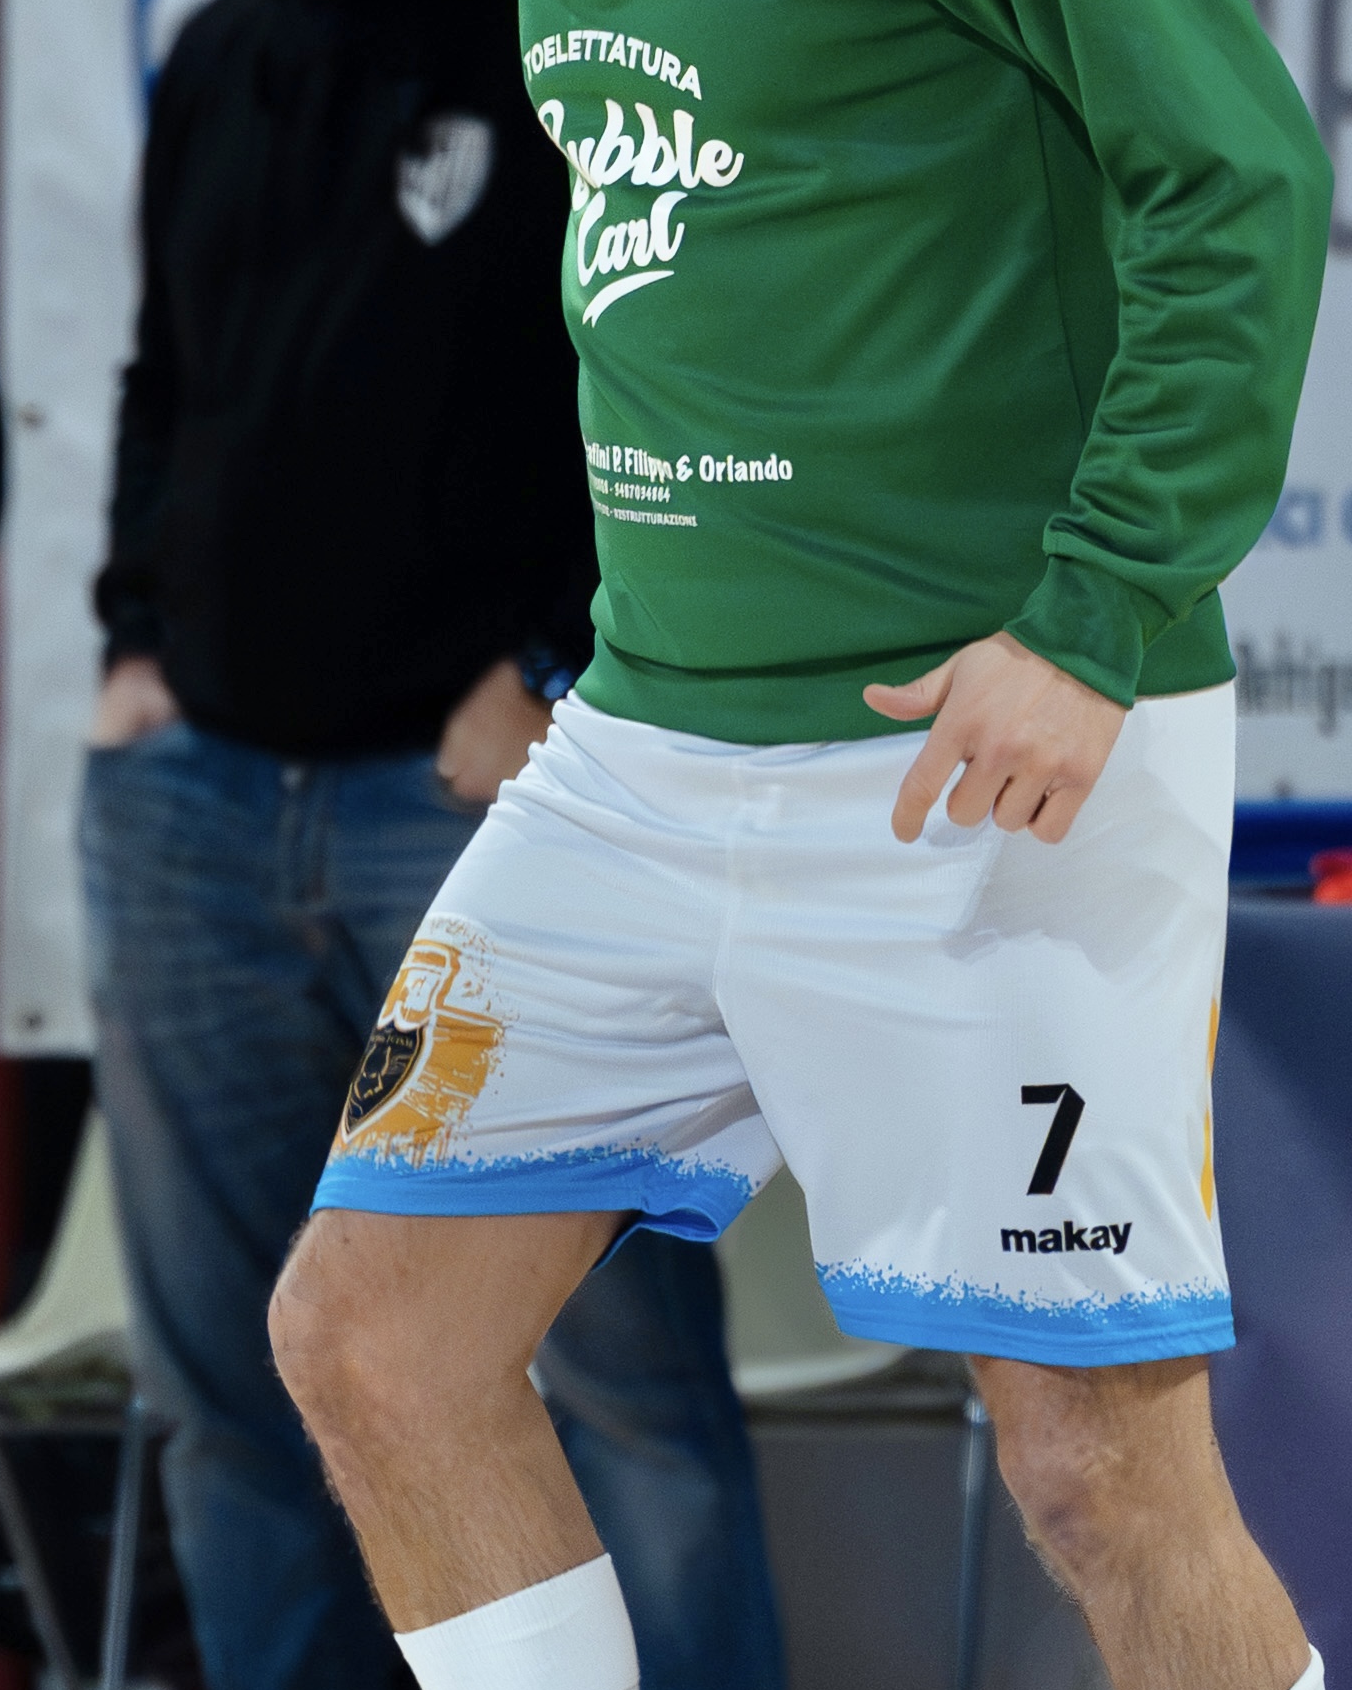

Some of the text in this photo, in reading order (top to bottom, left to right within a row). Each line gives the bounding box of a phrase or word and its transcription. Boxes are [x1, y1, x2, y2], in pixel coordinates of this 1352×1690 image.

[523, 29, 702, 101] TOELETTATURA
[577, 190, 688, 287] Carl
[676, 454, 694, 482] &
[699, 453, 793, 483] Orlando
[1021, 1083, 1086, 1196] 7
[1001, 1220, 1132, 1255] makay
